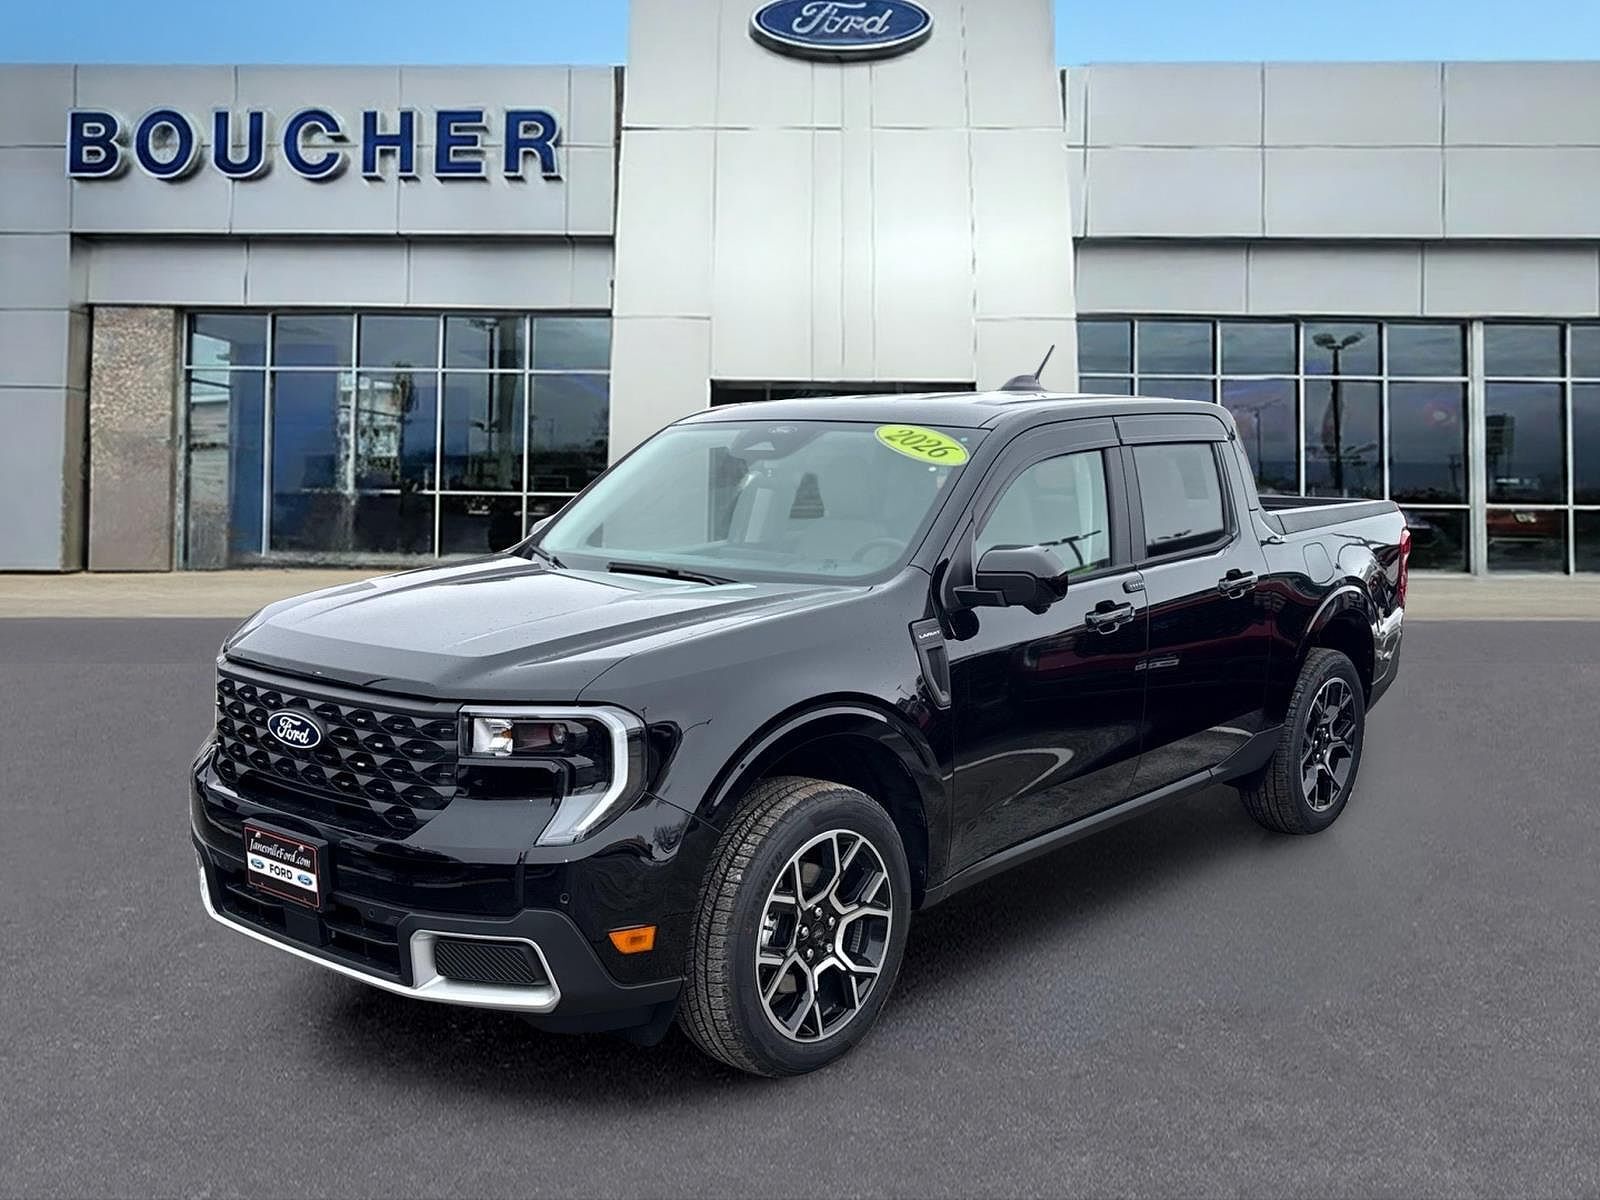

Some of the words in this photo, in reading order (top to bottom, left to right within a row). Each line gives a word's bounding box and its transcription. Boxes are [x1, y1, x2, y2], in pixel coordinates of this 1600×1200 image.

[791, 1, 893, 35] Ford
[67, 107, 562, 181] BOUCHER
[884, 429, 960, 458] 2026
[277, 716, 310, 744] Ford
[269, 863, 293, 880] FORD
